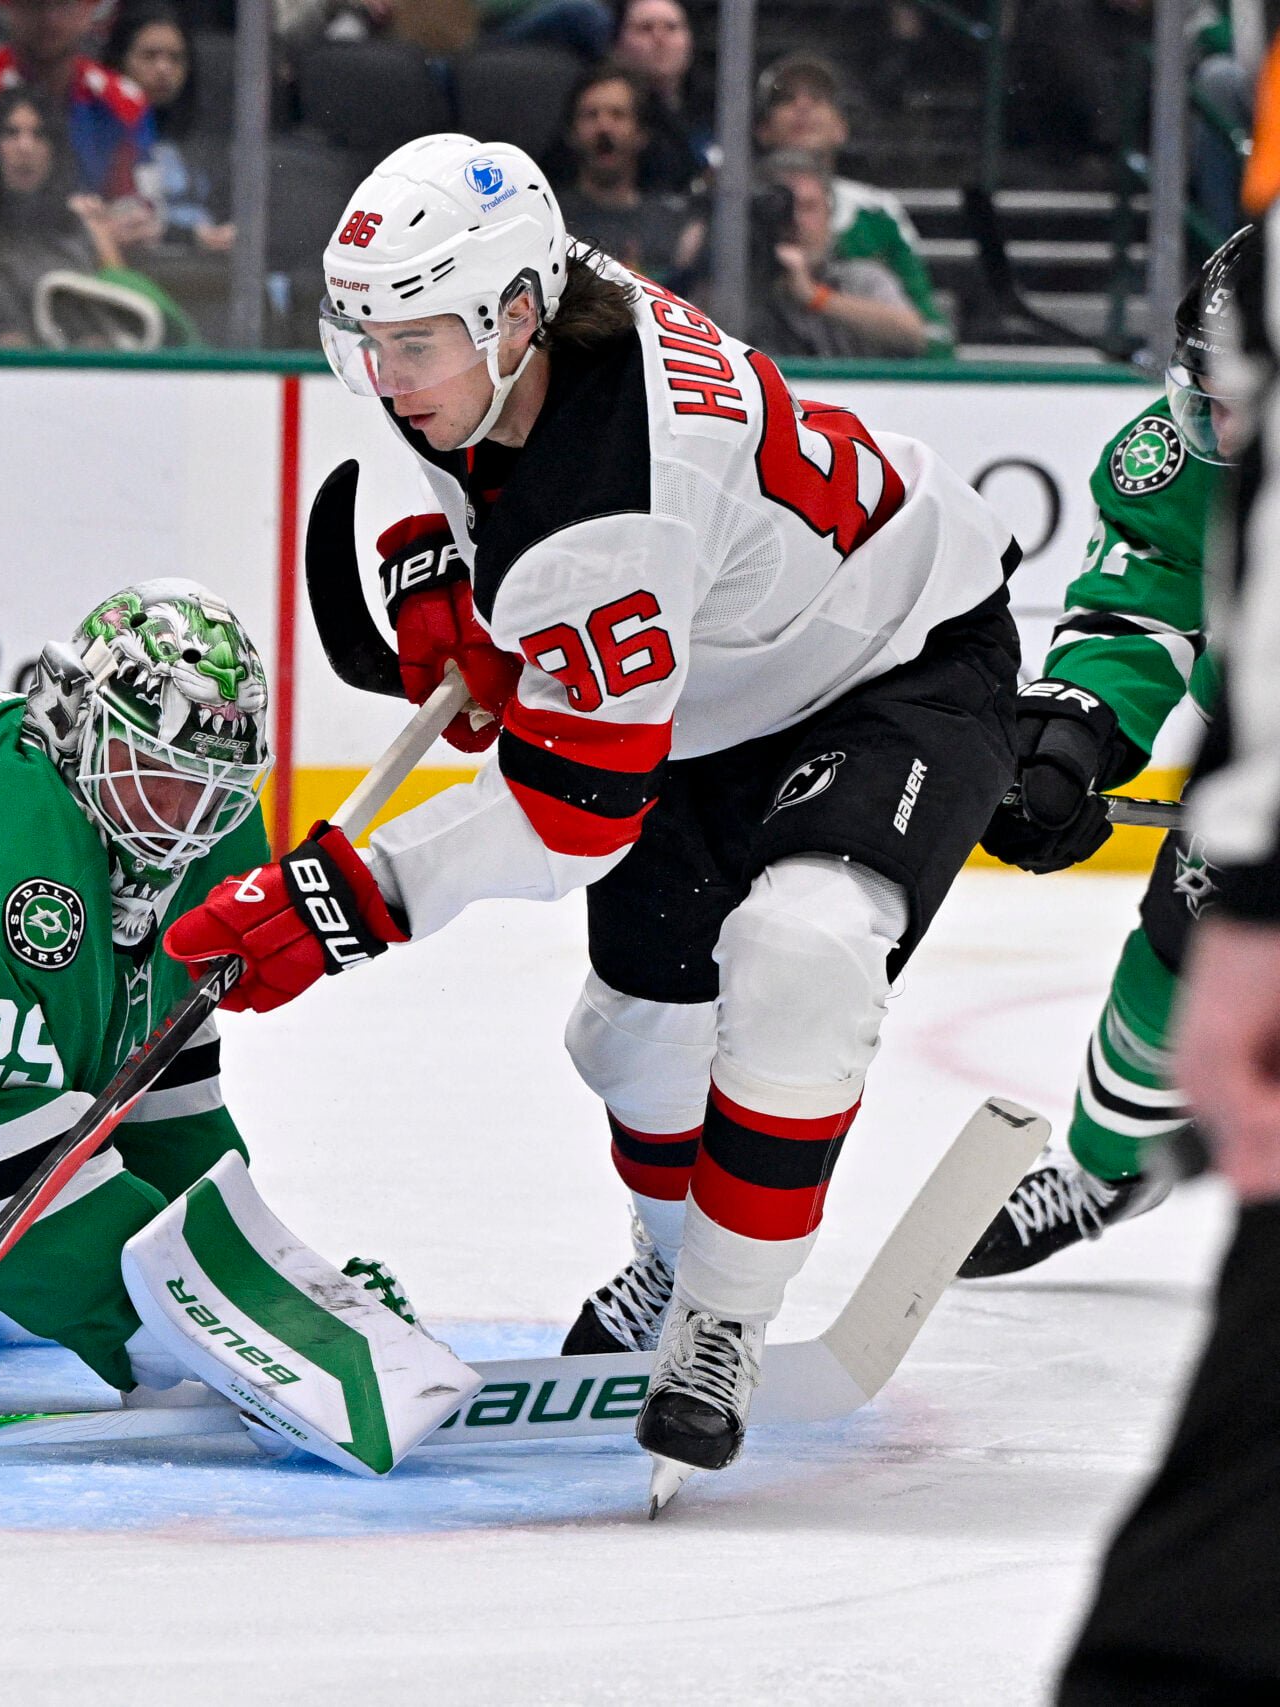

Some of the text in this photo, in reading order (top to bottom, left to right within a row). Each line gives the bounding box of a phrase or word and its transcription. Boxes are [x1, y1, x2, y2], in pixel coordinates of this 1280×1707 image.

[481, 186, 518, 214] Prudential
[338, 210, 383, 249] 86
[10, 913, 64, 963] STARS
[21, 884, 81, 940] DALLAS
[289, 857, 375, 970] BAU
[228, 1382, 309, 1442] SUPREME
[437, 1374, 650, 1430] AUE
